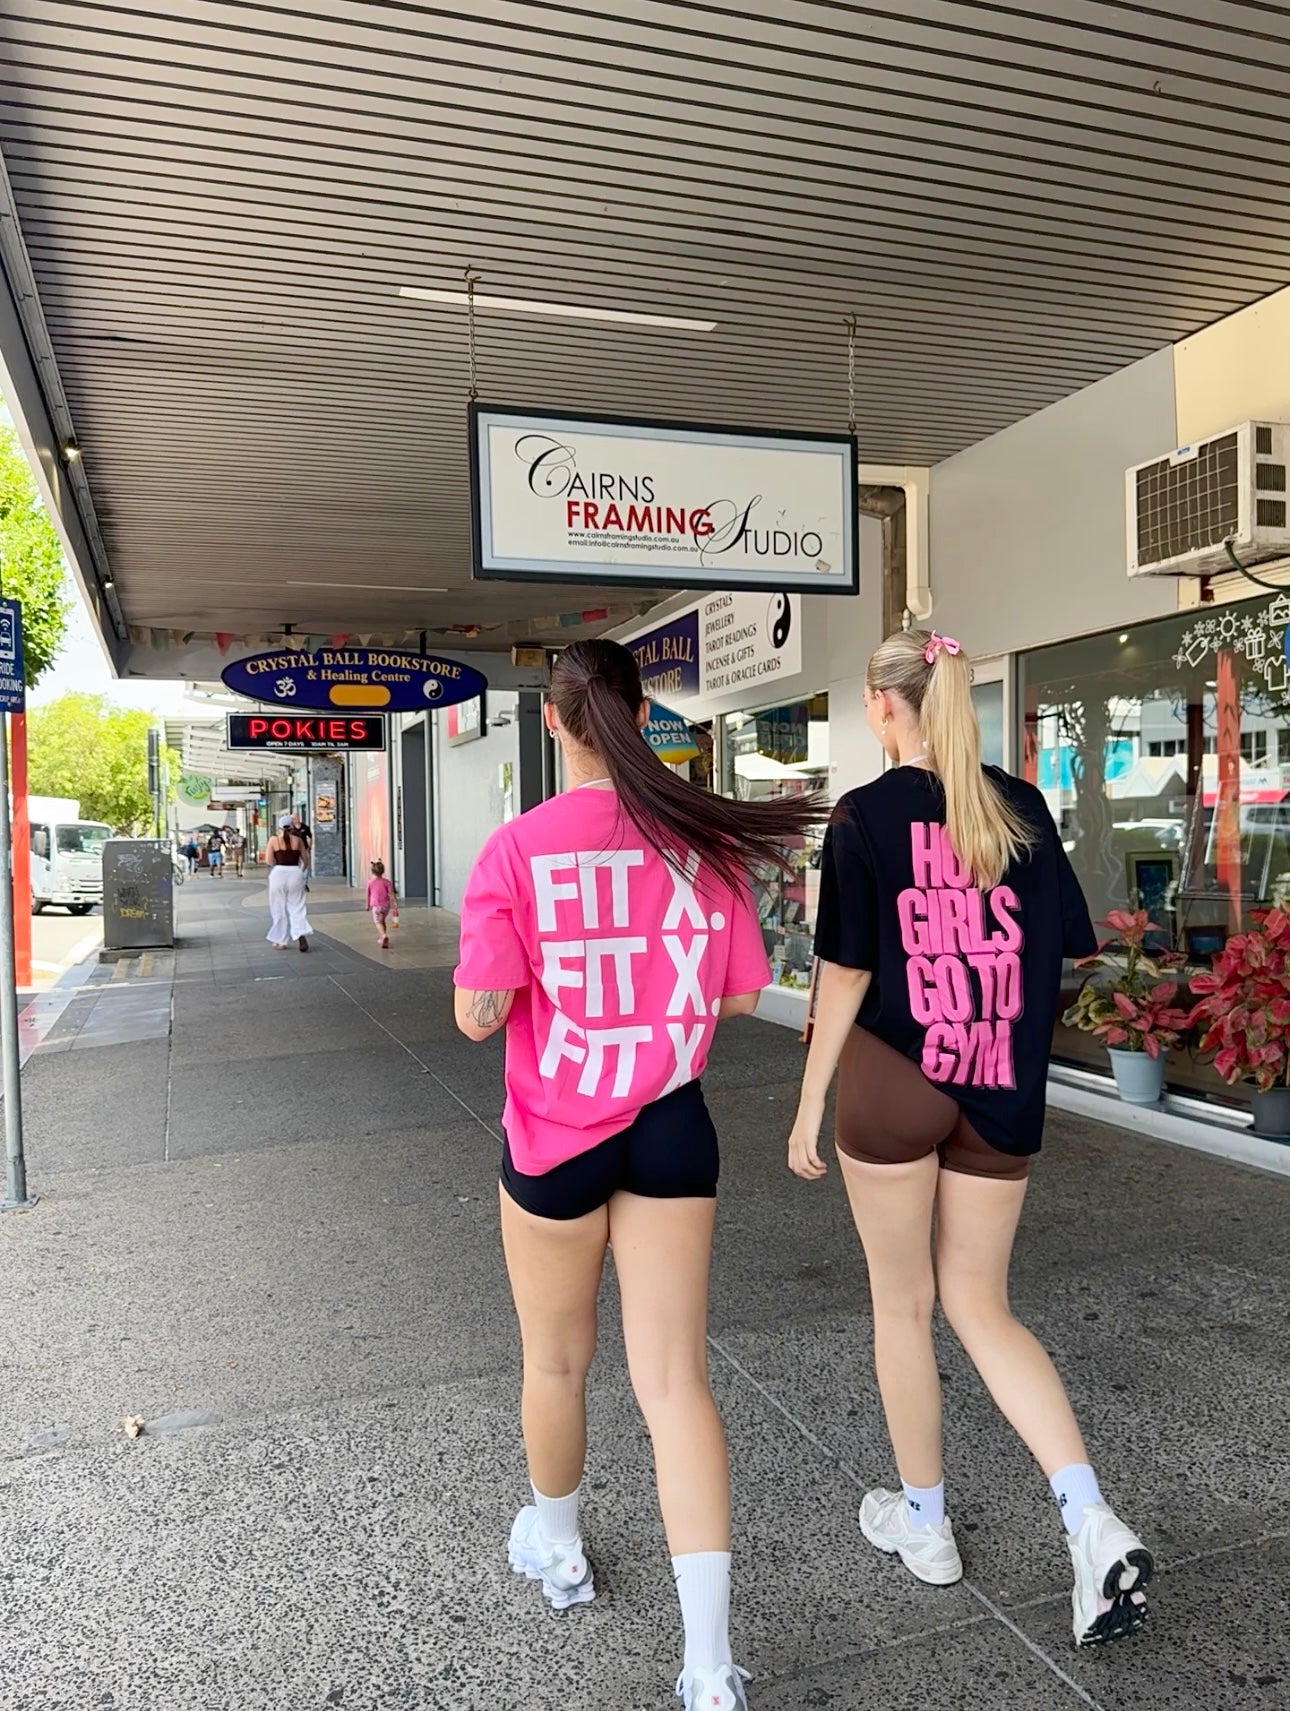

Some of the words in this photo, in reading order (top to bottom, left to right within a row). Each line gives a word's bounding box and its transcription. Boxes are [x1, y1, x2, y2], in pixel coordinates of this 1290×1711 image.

[515, 434, 655, 503] CAIRNS
[567, 500, 714, 536] FRAMING
[694, 494, 822, 567] STUDIO
[567, 531, 680, 544] www.cairnsframingstudio.com.au
[567, 539, 699, 553] email:info@cairnsframingstudio.com.au
[705, 592, 733, 617] CRYSTALS
[705, 612, 735, 638] JEWELLERY
[705, 636, 724, 654] TAROT
[725, 623, 757, 646] READINGS
[246, 653, 319, 675] CRYSTAL
[323, 652, 364, 666] BALL
[367, 653, 462, 680] BOOKSTORE
[632, 640, 660, 669] STAL
[662, 636, 695, 663] BALL
[705, 653, 730, 673] INCENSE
[730, 652, 736, 665] &
[736, 644, 755, 662] GIFTS
[306, 671, 317, 681] &
[321, 669, 368, 684] Healing
[371, 671, 411, 682] Centre
[641, 666, 683, 698] KSTORE
[705, 675, 724, 692] TAROT
[725, 673, 730, 686] &
[731, 664, 756, 684] ORACLE
[757, 656, 781, 676] CARDS
[250, 719, 367, 740] POKIES
[648, 719, 684, 732] NOW
[649, 732, 692, 746] OPEN
[911, 821, 977, 889] HO
[530, 850, 645, 932] FIT
[897, 885, 1025, 956] GIRLS
[540, 936, 648, 1018] FIT
[661, 934, 721, 1017] X.
[906, 954, 973, 1025] GO
[967, 952, 1024, 1022] TO
[538, 1007, 653, 1099] FIT
[920, 1019, 1017, 1090] GYM
